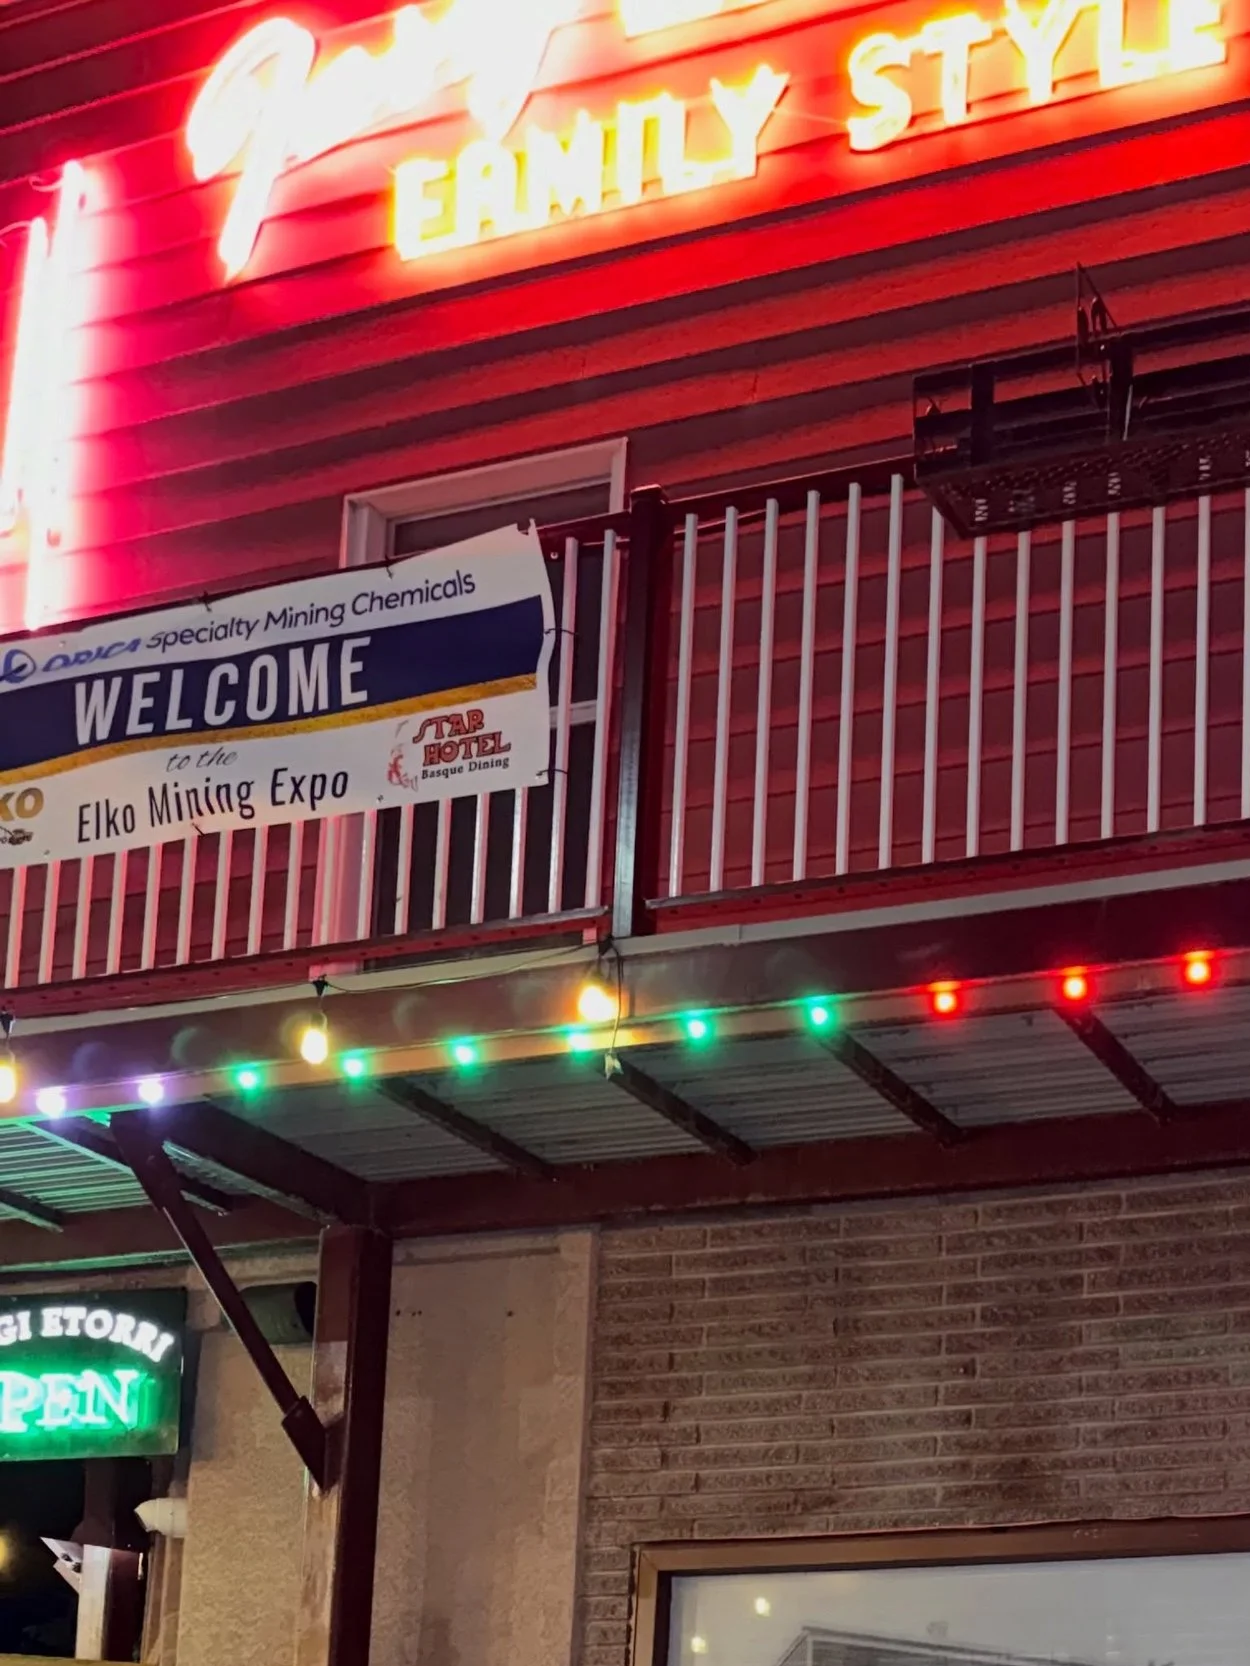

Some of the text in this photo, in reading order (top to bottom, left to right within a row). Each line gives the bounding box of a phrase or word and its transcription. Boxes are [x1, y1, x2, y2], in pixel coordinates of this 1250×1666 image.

[847, 0, 1227, 153] STYLE
[146, 616, 260, 653] Specialty
[263, 602, 346, 632] Mining
[351, 569, 477, 616] Chemicals
[74, 636, 372, 746] WELCOME
[412, 708, 485, 744] STAR
[422, 731, 512, 768] HOTEL
[166, 746, 239, 773] to the
[421, 756, 510, 781] Basque Dining
[77, 768, 349, 844] Elko Mining Expo
[0, 1307, 175, 1363] GI ETORRI
[0, 1369, 140, 1434] PEN
